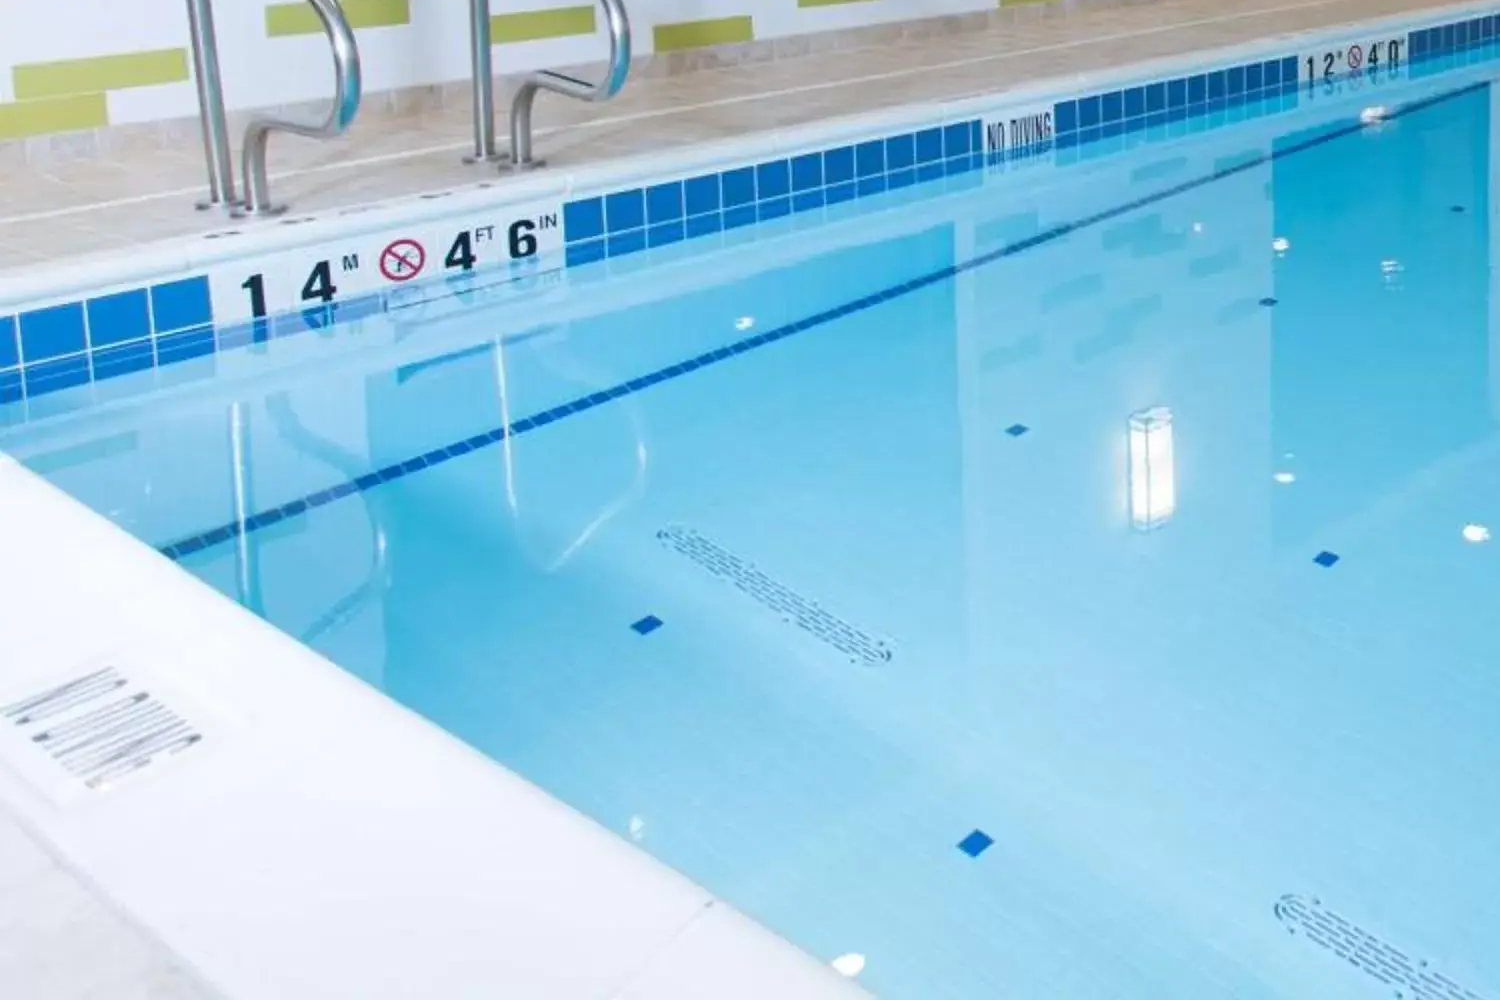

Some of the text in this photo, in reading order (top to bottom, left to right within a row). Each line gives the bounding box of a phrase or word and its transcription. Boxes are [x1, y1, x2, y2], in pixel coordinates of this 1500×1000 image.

[987, 111, 1052, 152] NO DIVING
[342, 253, 359, 272] M
[444, 230, 477, 271] 4
[475, 225, 496, 244] FT
[508, 219, 537, 259] 6
[538, 212, 558, 232] IN
